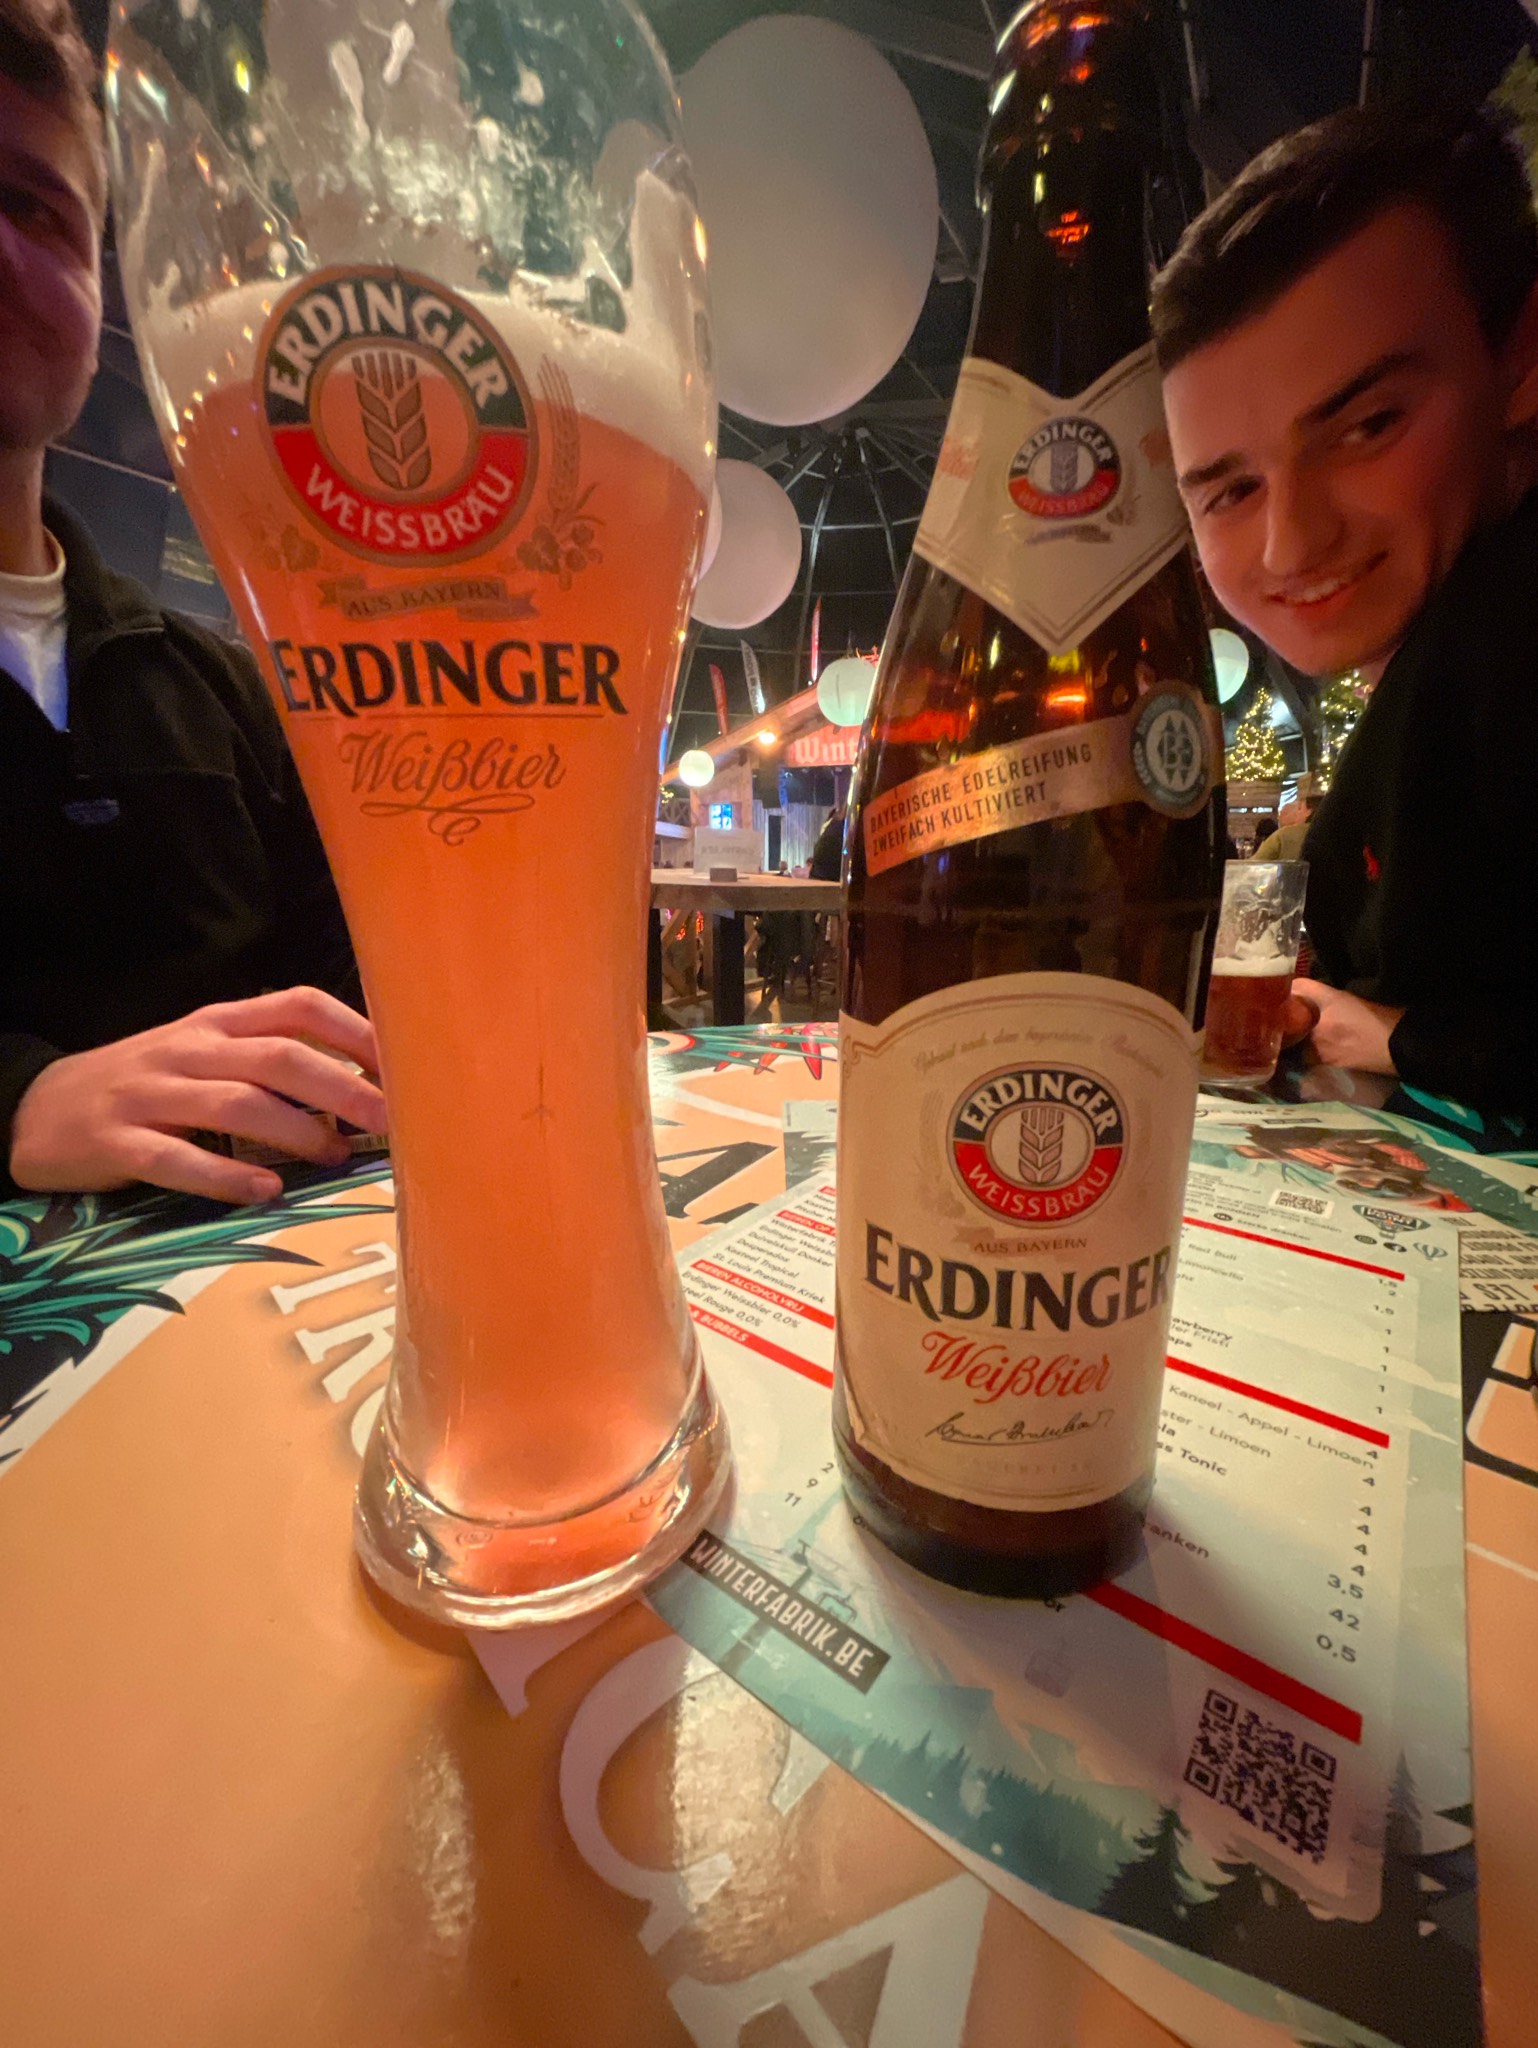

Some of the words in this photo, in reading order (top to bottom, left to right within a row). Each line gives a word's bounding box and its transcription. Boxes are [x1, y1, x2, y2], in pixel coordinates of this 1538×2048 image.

[268, 281, 509, 409] ERDINGER
[1013, 423, 1113, 468] ERDINGER
[268, 636, 629, 717] ERDINGER
[339, 729, 567, 806] Weißbier
[870, 783, 952, 833] BAYERISCHE
[962, 743, 1093, 795] EDELREIFUNG
[872, 811, 936, 857] ZWEIFACH
[940, 781, 1047, 829] KULTIVIERT
[959, 1073, 1118, 1136] ERDINGER
[975, 1241, 1008, 1254] AUS
[1016, 1237, 1088, 1253] BAYERN
[696, 1261, 732, 1280] BIEREN
[727, 1258, 752, 1272] Louis
[753, 1269, 797, 1290] Premium
[797, 1288, 826, 1304] Kriek
[864, 1219, 1172, 1332] ERDINGER
[703, 1296, 735, 1313] Rouge
[921, 1330, 1114, 1405] Weißbier
[1168, 1384, 1223, 1411] Kaneel
[1238, 1412, 1289, 1436] Appel
[1307, 1436, 1373, 1469] Limoen
[1209, 1426, 1271, 1458] Limoen
[1366, 1450, 1378, 1460] 4
[821, 1462, 834, 1474] 2
[1181, 1447, 1228, 1476] Tonic
[806, 1477, 819, 1488] 9
[1362, 1477, 1375, 1487] 4
[784, 1492, 802, 1507] 11
[1359, 1505, 1372, 1516] 4
[1356, 1524, 1370, 1535] 4
[1353, 1543, 1368, 1555] 4
[1351, 1564, 1366, 1577] 4
[1327, 1573, 1364, 1600] 3.5
[690, 1538, 875, 1677] WINTERFABRIK.BE
[1329, 1608, 1361, 1631] 42
[1316, 1634, 1357, 1663] 0.5
